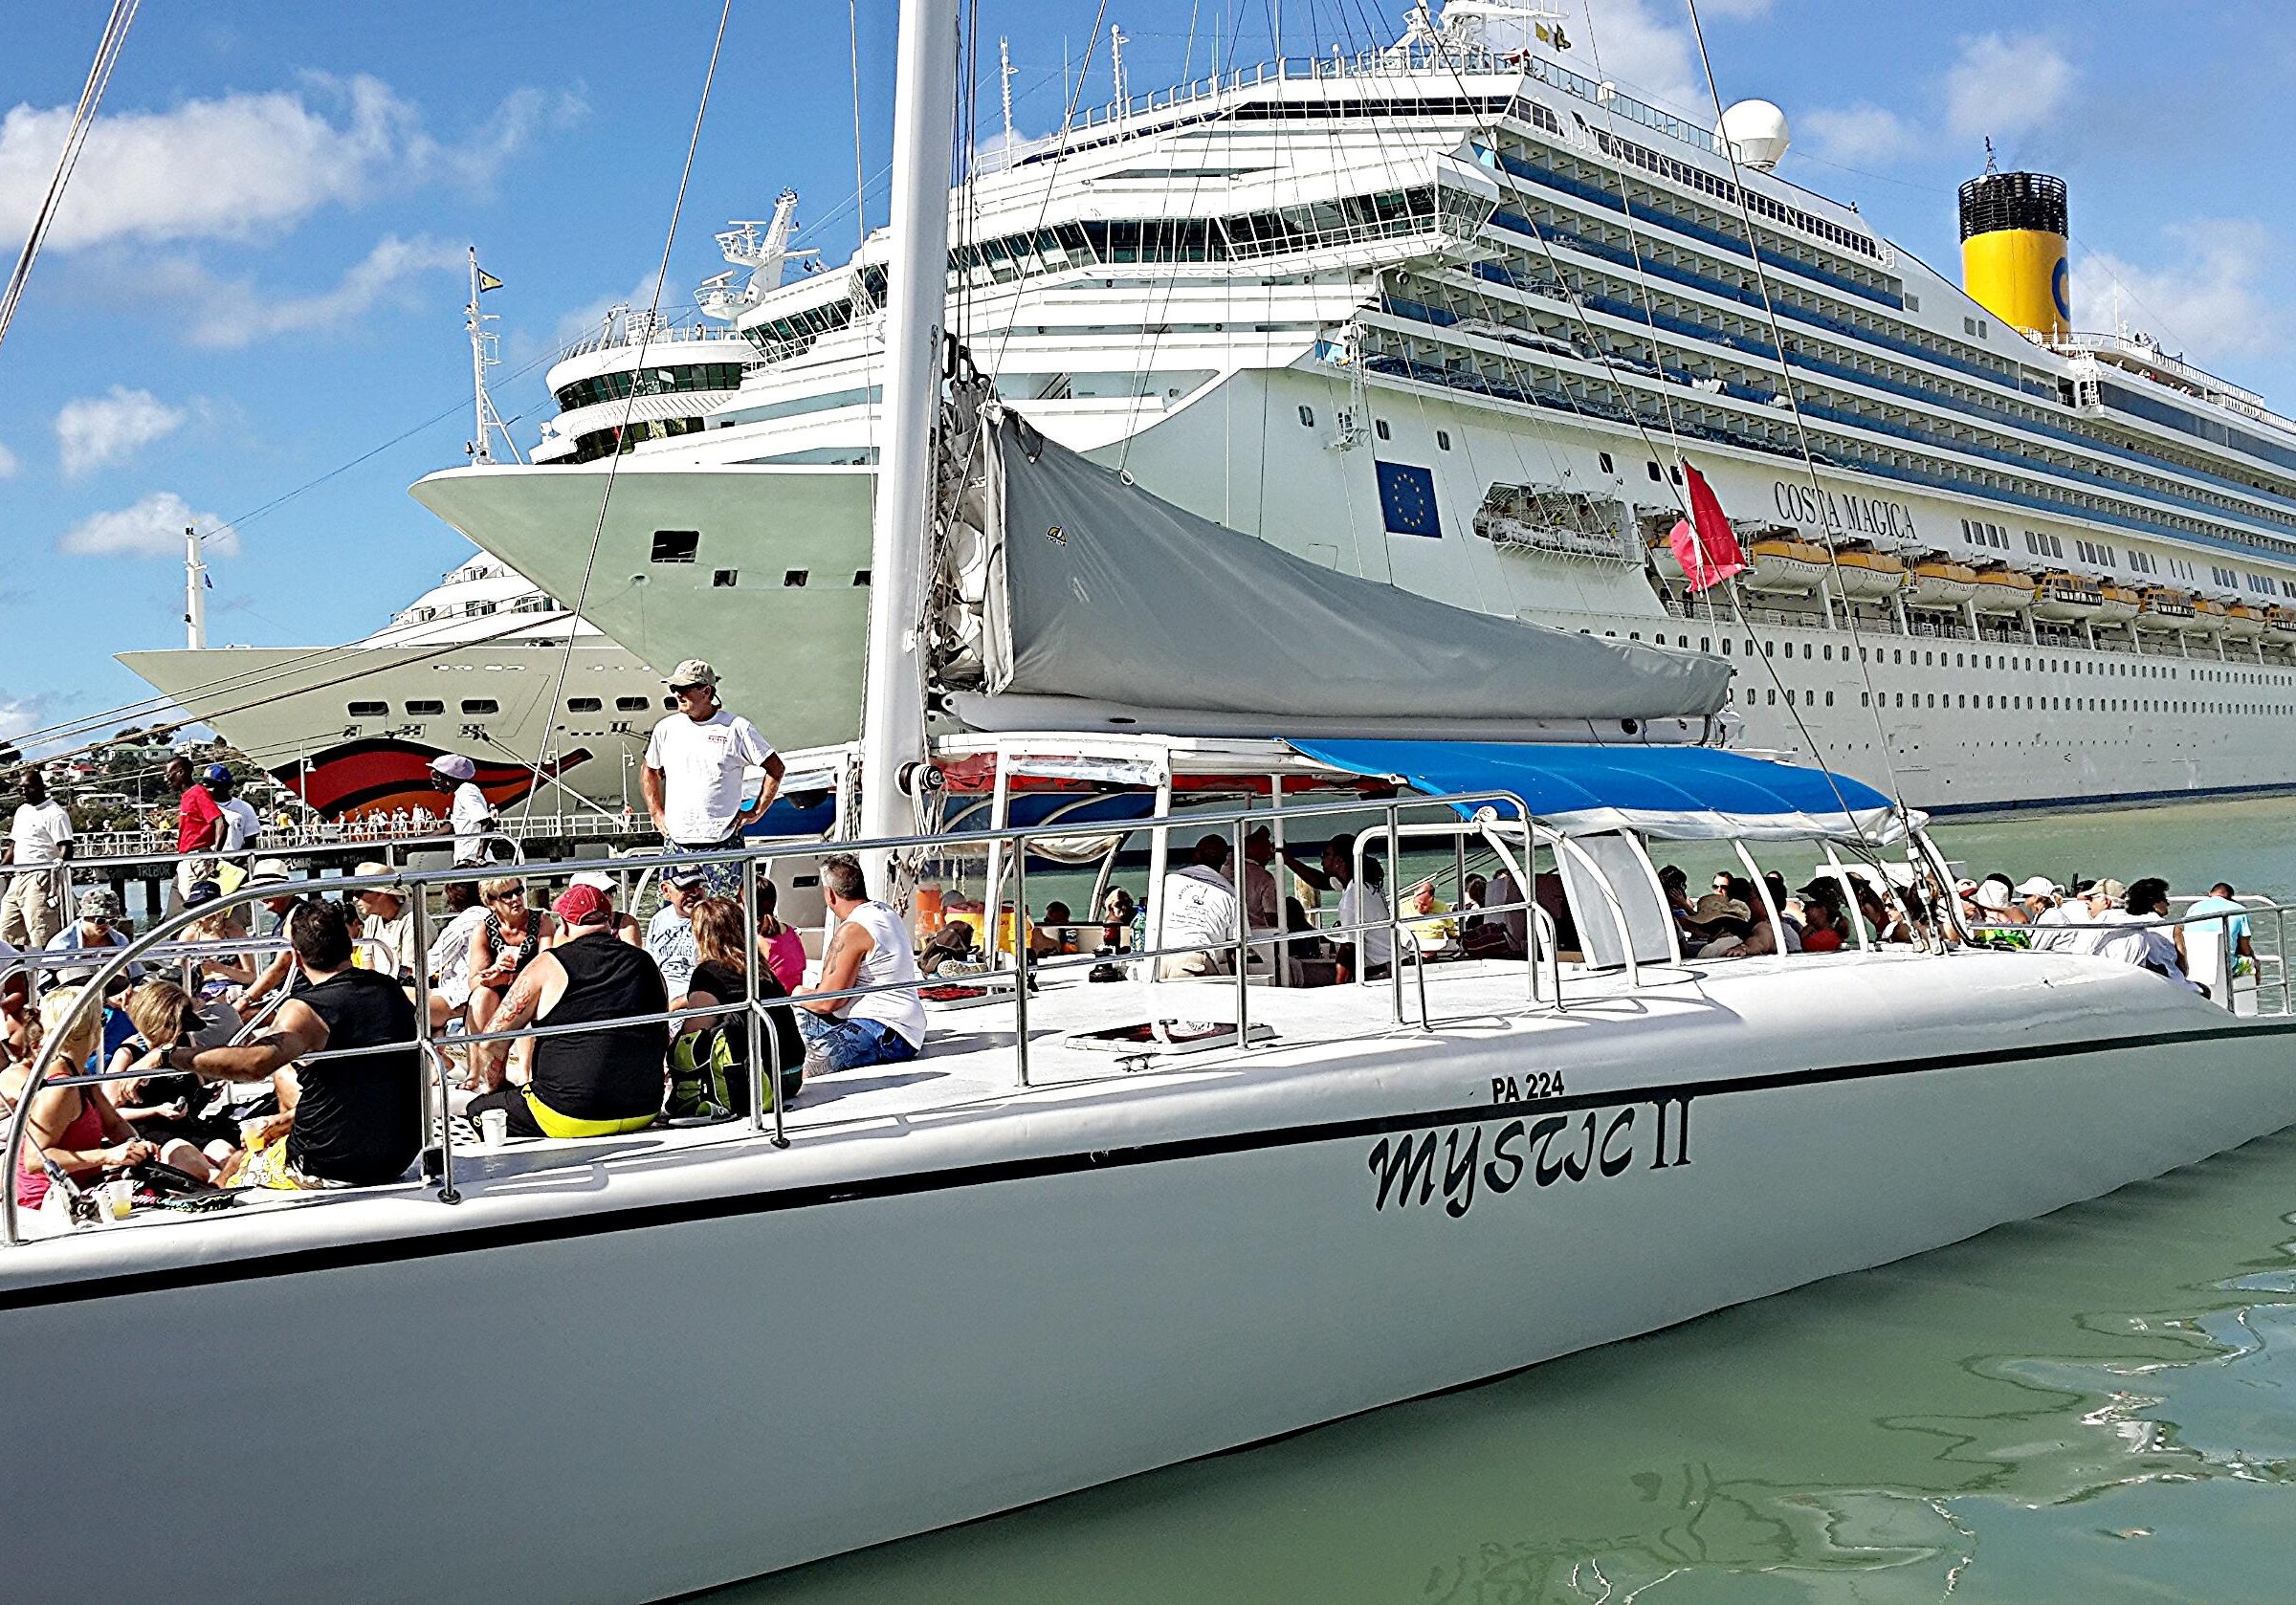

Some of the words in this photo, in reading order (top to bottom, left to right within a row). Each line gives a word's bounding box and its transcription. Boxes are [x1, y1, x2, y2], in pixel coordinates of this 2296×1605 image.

[1775, 481, 1842, 528] COSTA
[1843, 494, 1918, 540] MAGICA
[1491, 1077, 1520, 1104] PA
[1526, 1069, 1564, 1099] 224
[1649, 1095, 1695, 1170] II
